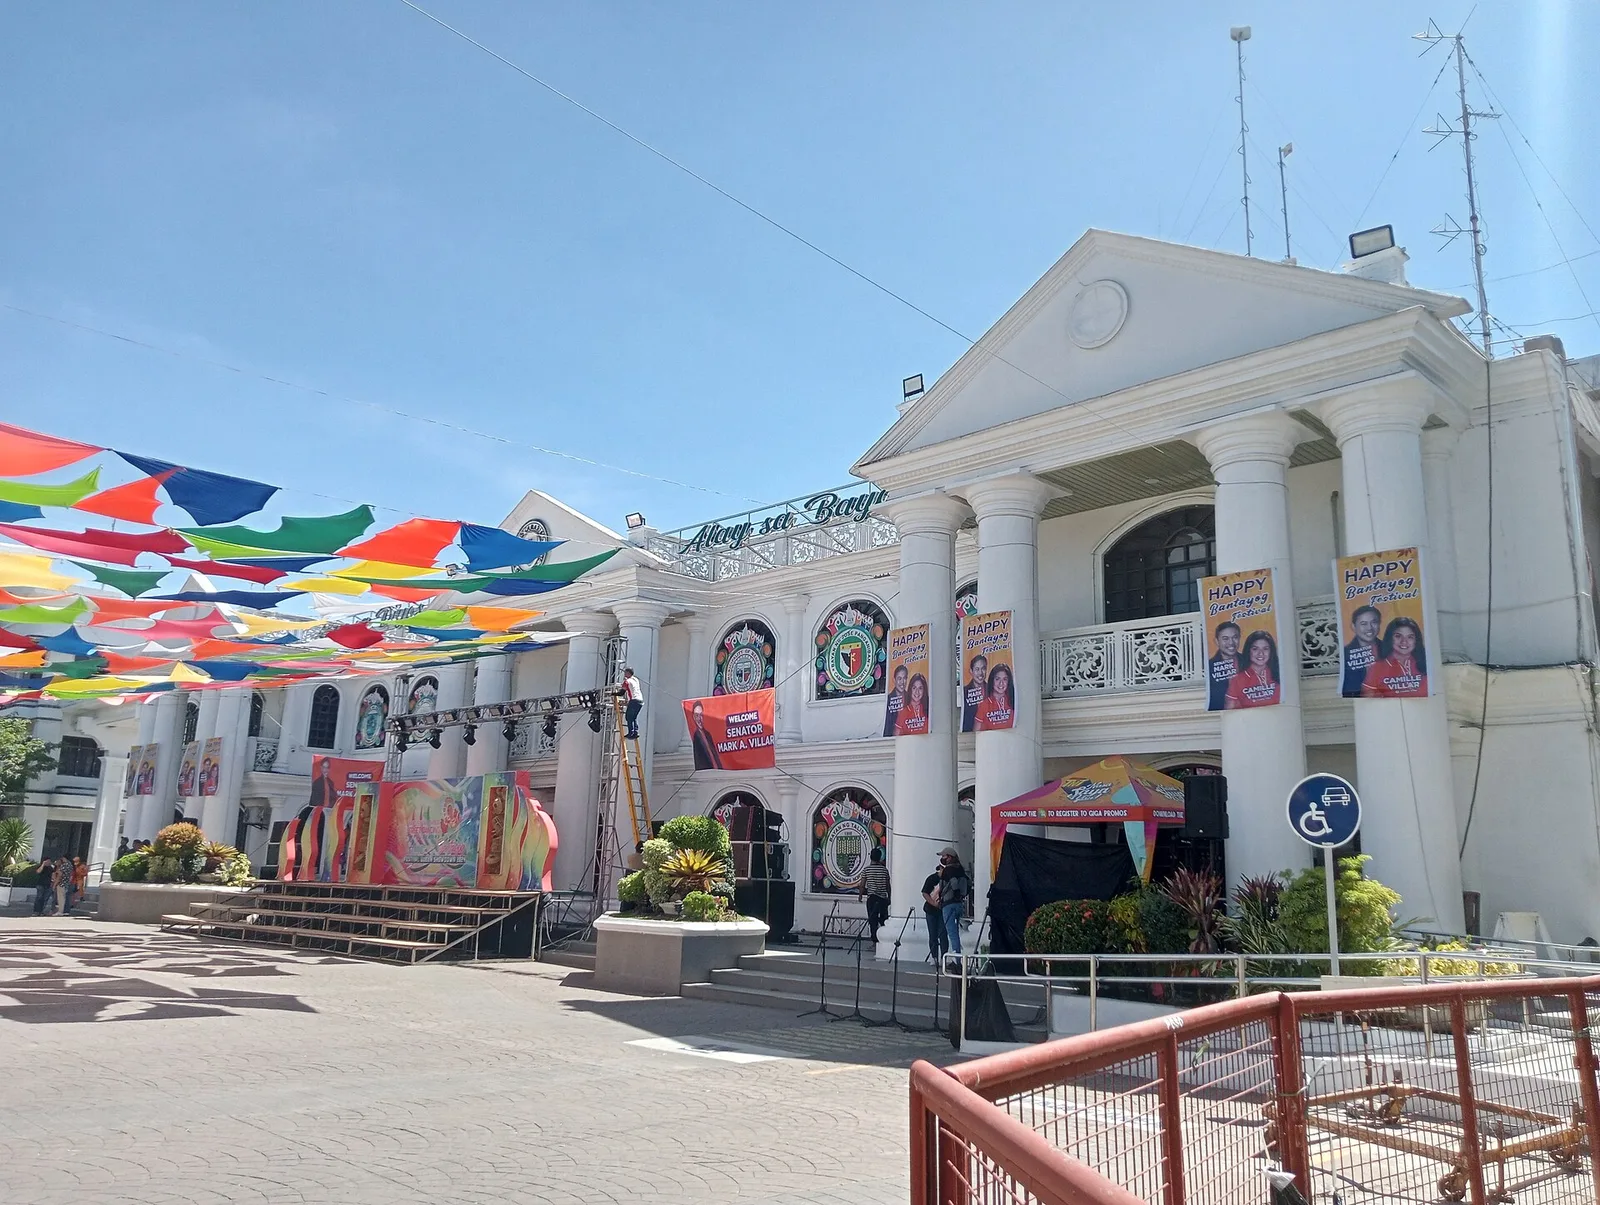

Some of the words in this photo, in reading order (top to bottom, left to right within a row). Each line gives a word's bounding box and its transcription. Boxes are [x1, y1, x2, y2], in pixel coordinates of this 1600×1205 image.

[679, 522, 752, 554] Alay
[759, 512, 796, 535] sa
[1345, 559, 1412, 583] HAPPY
[1209, 577, 1266, 600] HAPPY
[1346, 577, 1414, 600] Bantayog
[1210, 593, 1268, 616] Bantayog
[1370, 588, 1417, 607] Festival
[1232, 604, 1272, 622] Festival
[967, 618, 1008, 636] HAPPY
[892, 630, 926, 647] HAPPY
[967, 632, 1009, 650] Bantayog
[892, 644, 926, 660] Bantayog
[982, 642, 1010, 655] Festival
[1349, 645, 1372, 654] SENATOR
[1349, 650, 1372, 660] MARK
[1214, 663, 1234, 672] MARK
[1347, 656, 1375, 667] VILLAR
[1212, 669, 1237, 679] VILLAR
[1383, 674, 1421, 684] CAMILLE
[1242, 683, 1275, 694] CAMILLE
[1388, 681, 1420, 690] VILLAR
[1246, 689, 1274, 699] VILLAR
[728, 712, 758, 724] WELCOME
[986, 709, 1011, 717] CAMILLE
[727, 724, 763, 738] SENATOR
[717, 741, 738, 752] MARK
[740, 740, 747, 750] A.
[749, 735, 775, 748] VILLAR
[851, 823, 869, 841] TALISAY
